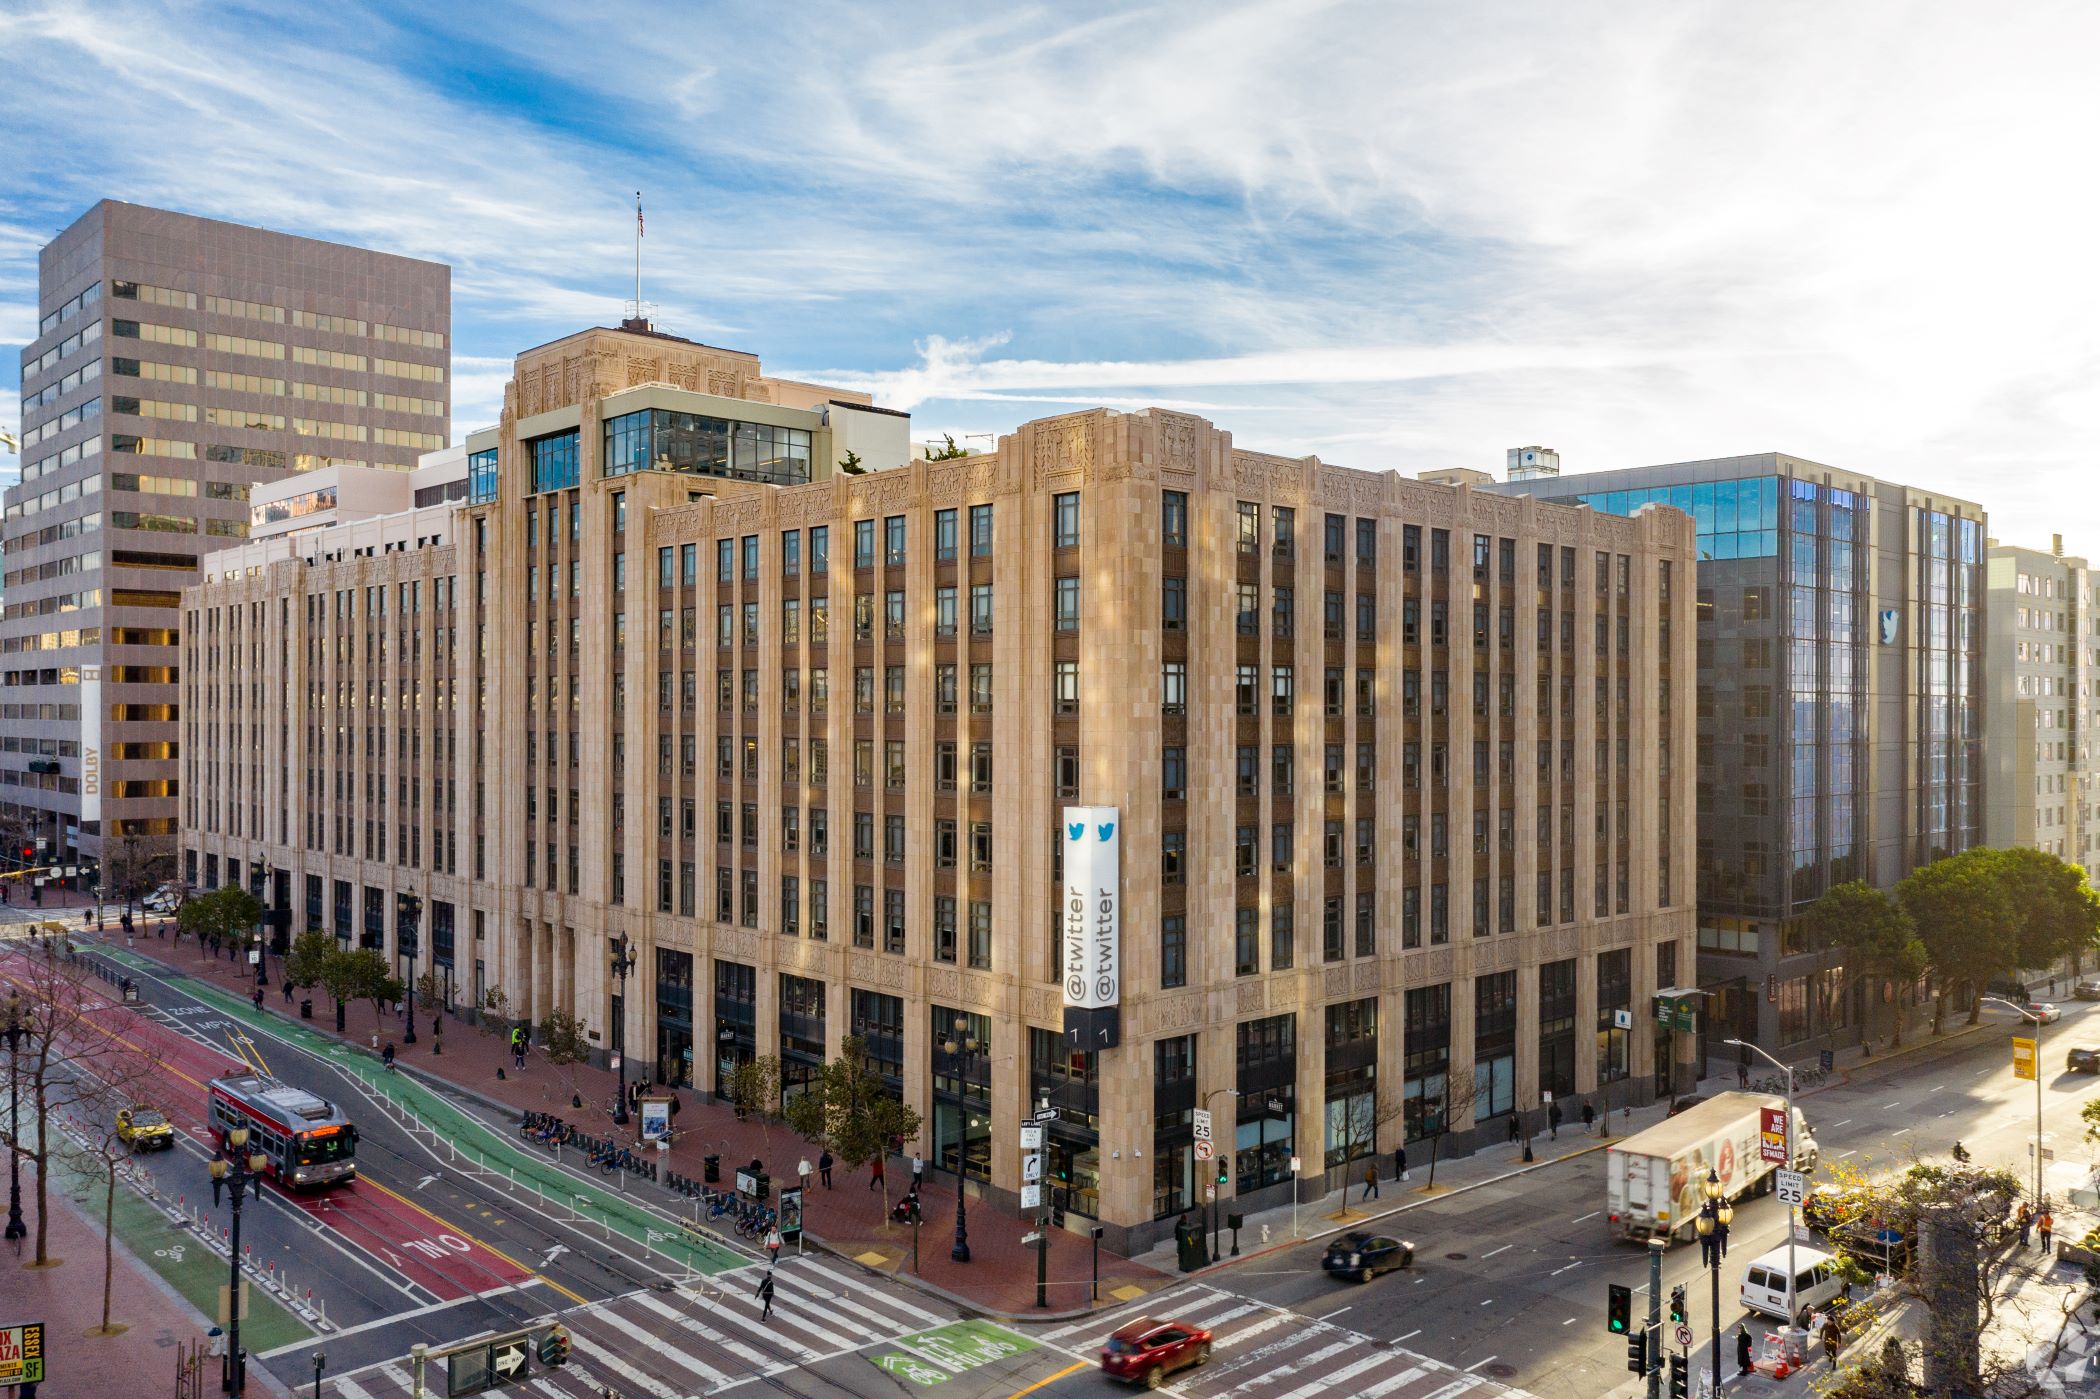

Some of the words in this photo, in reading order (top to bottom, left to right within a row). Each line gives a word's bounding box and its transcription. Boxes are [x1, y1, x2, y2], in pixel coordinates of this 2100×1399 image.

[86, 747, 98, 795] DOLBY
[1066, 886, 1087, 1001] @twitter
[1095, 887, 1116, 1002] @twitter
[168, 1006, 212, 1016] ZONE
[195, 1020, 233, 1030] MPH
[1070, 1028, 1079, 1043] 1
[1098, 1027, 1109, 1044] 1
[1772, 1114, 1784, 1125] WE
[1195, 1125, 1210, 1137] 25
[1770, 1123, 1784, 1135] ARE
[1762, 1148, 1785, 1160] SFMADE
[1778, 1172, 1802, 1182] SPEED
[1779, 1188, 1802, 1203] 25
[24, 1327, 40, 1358] ESSEX
[497, 1359, 508, 1367] ONE
[512, 1354, 523, 1363] WAY
[26, 1361, 39, 1379] SF
